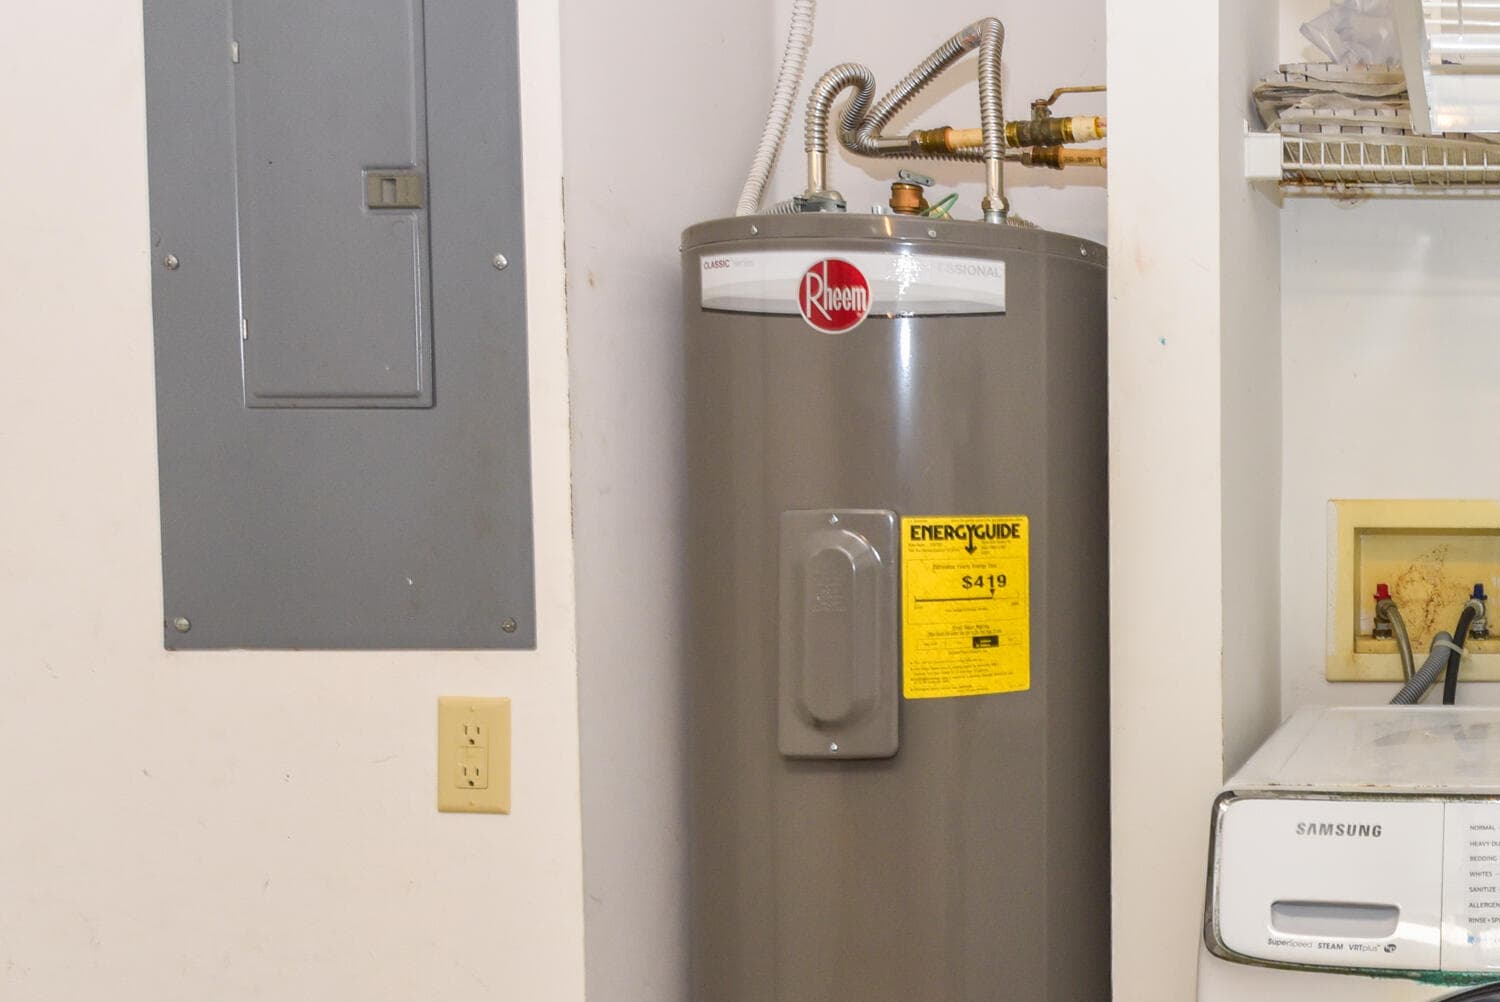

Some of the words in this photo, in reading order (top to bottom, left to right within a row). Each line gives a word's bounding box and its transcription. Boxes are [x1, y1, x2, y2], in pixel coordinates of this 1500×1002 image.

[704, 259, 730, 270] CLASSIC
[806, 260, 867, 321] Rheem
[910, 523, 1021, 541] ENERGYGUIDE
[962, 574, 1007, 589] $419
[1296, 822, 1383, 838] SAMSUNG
[1317, 942, 1344, 950] STEAM
